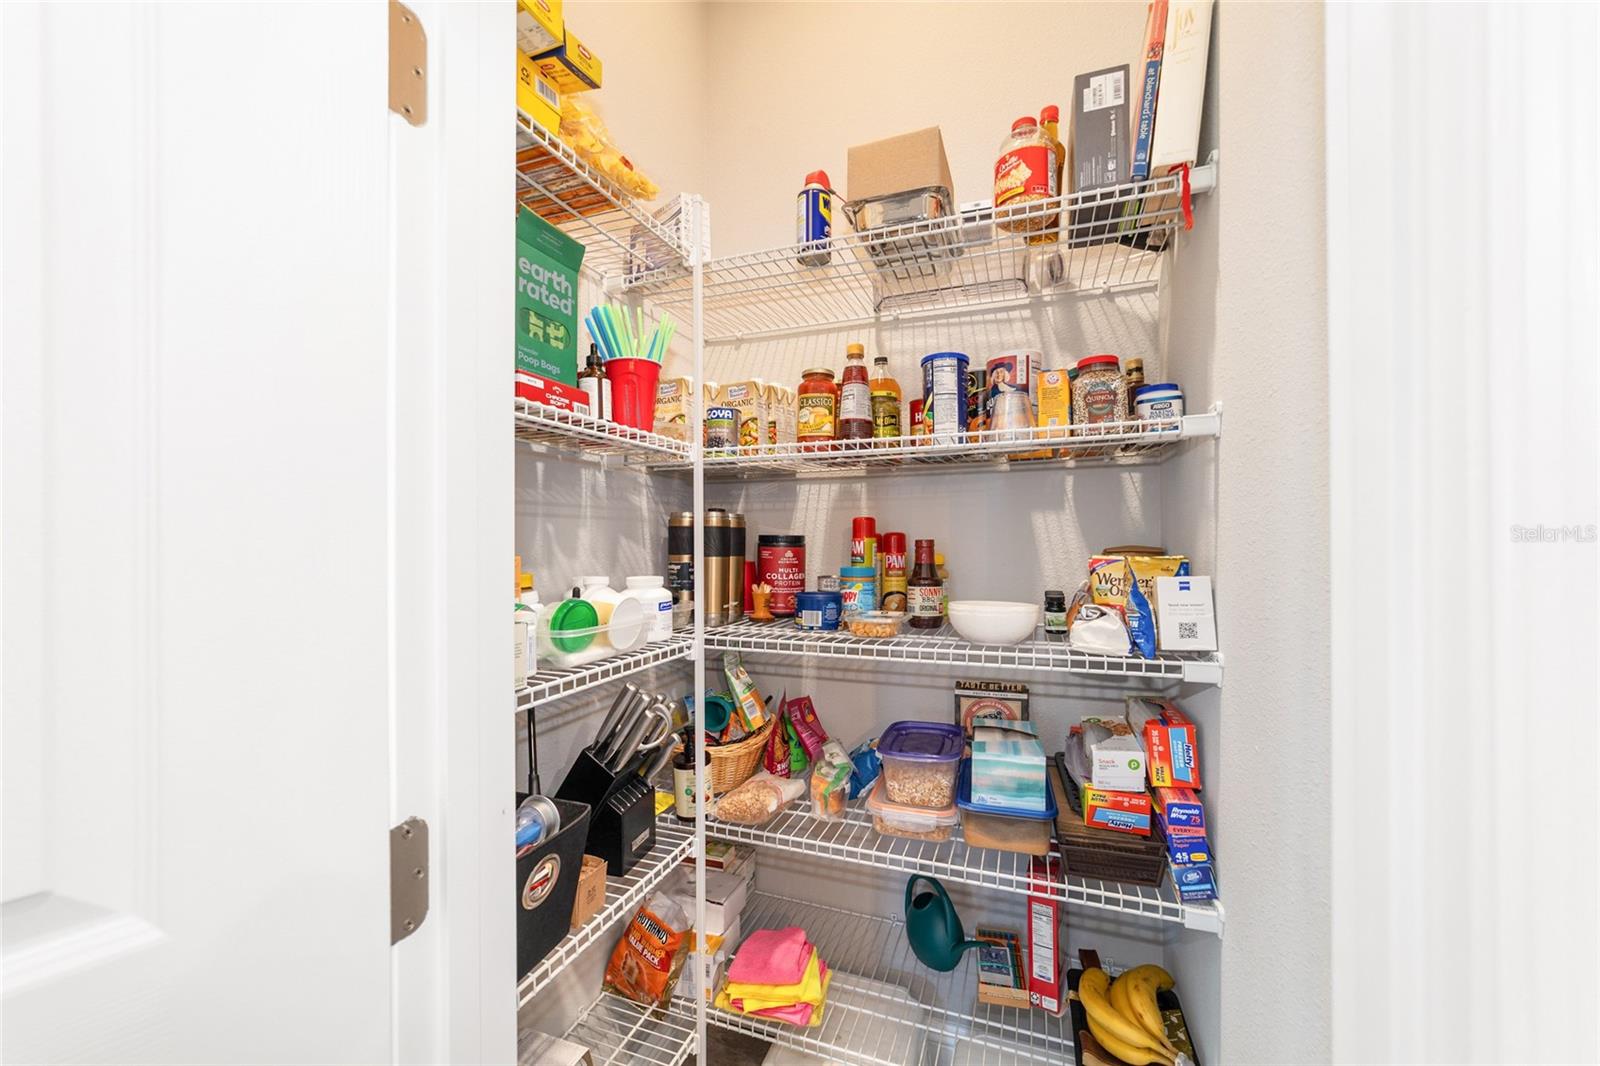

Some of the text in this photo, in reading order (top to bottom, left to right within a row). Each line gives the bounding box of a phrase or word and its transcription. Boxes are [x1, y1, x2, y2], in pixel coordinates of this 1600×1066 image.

[1140, 120, 1149, 139] table
[519, 257, 572, 298] earth
[519, 276, 572, 316] rated
[518, 351, 561, 375] Poop Bags
[656, 395, 683, 405] RGANIC
[721, 398, 754, 408] ORGANIC
[800, 397, 833, 407] CLASSICO
[1085, 395, 1114, 403] QUINOA
[852, 541, 864, 554] AM
[886, 555, 905, 568] PAM
[960, 680, 1023, 692] TASTE BETTER
[1184, 743, 1193, 768] Hefty
[1171, 812, 1188, 820] Wrap
[1172, 806, 1201, 815] Reynolds
[1108, 820, 1132, 829] Hefty
[1175, 852, 1189, 860] 45
[642, 947, 660, 966] PACK
